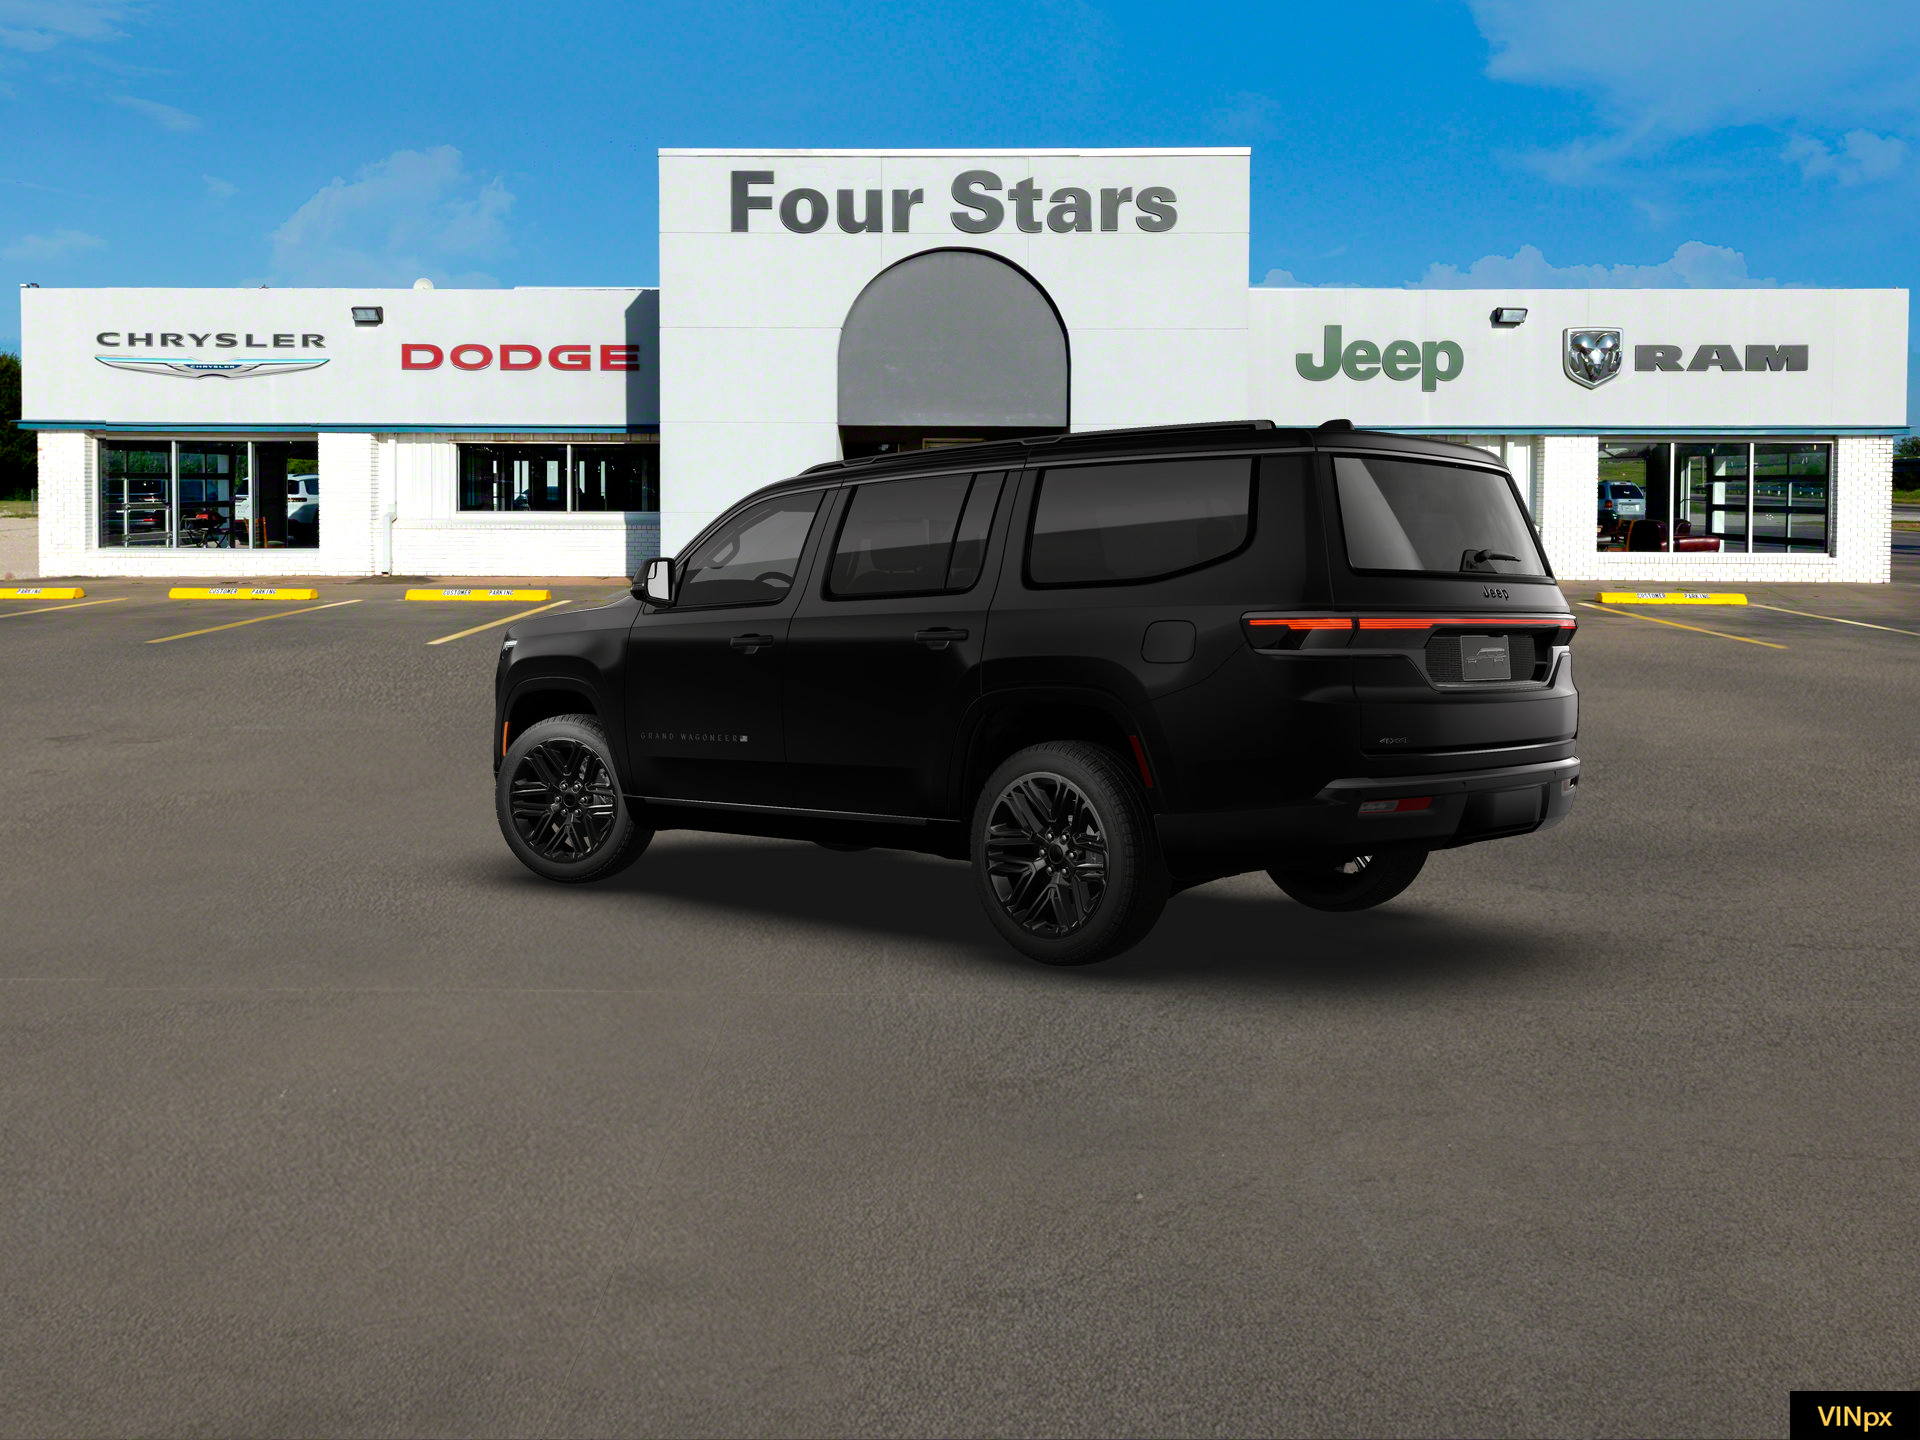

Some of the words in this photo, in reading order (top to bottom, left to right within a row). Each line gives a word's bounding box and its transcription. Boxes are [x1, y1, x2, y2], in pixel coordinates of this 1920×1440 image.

[730, 169, 925, 234] Four
[949, 169, 1179, 234] Stars
[95, 331, 328, 349] CHRYSLER
[401, 343, 641, 371] DODGE
[1295, 324, 1465, 393] Jeep
[1634, 344, 1809, 372] RAM
[1482, 585, 1509, 601] Jeep
[640, 731, 675, 740] GRAND
[680, 732, 738, 742] WAGONEER
